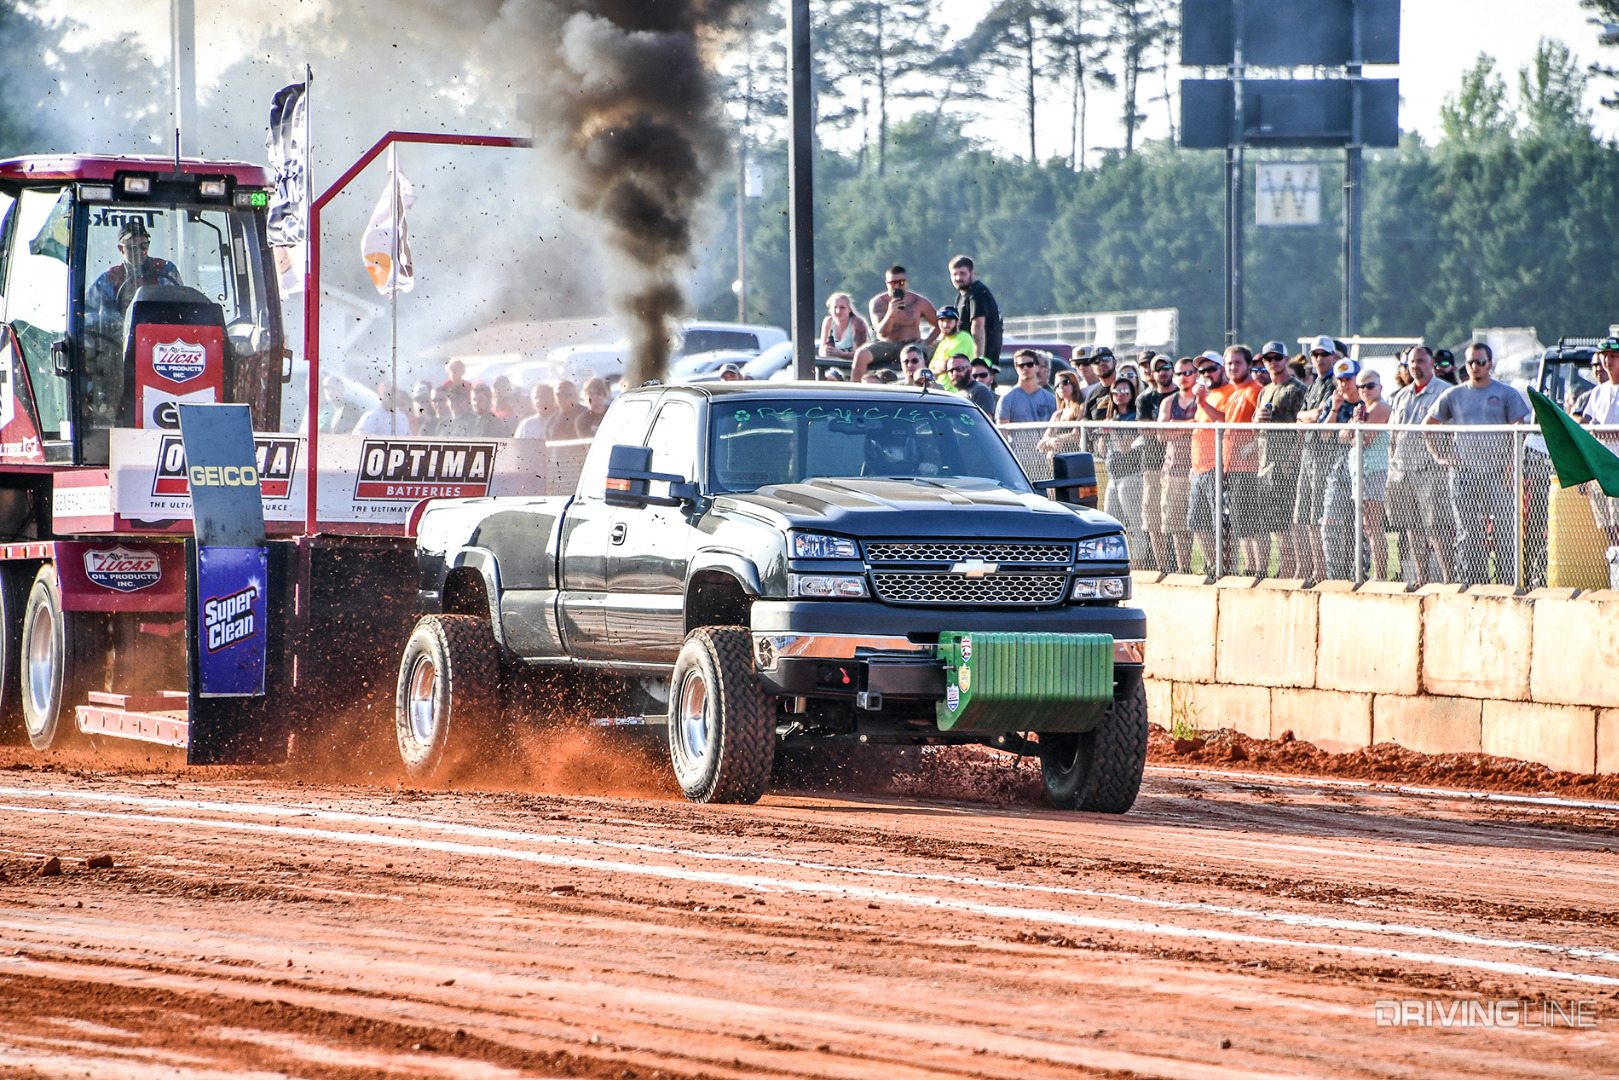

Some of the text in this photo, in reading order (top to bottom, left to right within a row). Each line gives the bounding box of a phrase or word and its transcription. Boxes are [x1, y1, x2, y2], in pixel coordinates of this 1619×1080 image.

[159, 352, 202, 364] LUCAS
[366, 448, 485, 478] OPTIMA
[189, 465, 258, 487] GEICO
[386, 485, 461, 497] BATTERIES
[150, 501, 165, 509] THE
[352, 505, 367, 513] THE
[95, 560, 155, 571] LUCAS
[205, 589, 256, 627] Super
[208, 614, 254, 650] Clean
